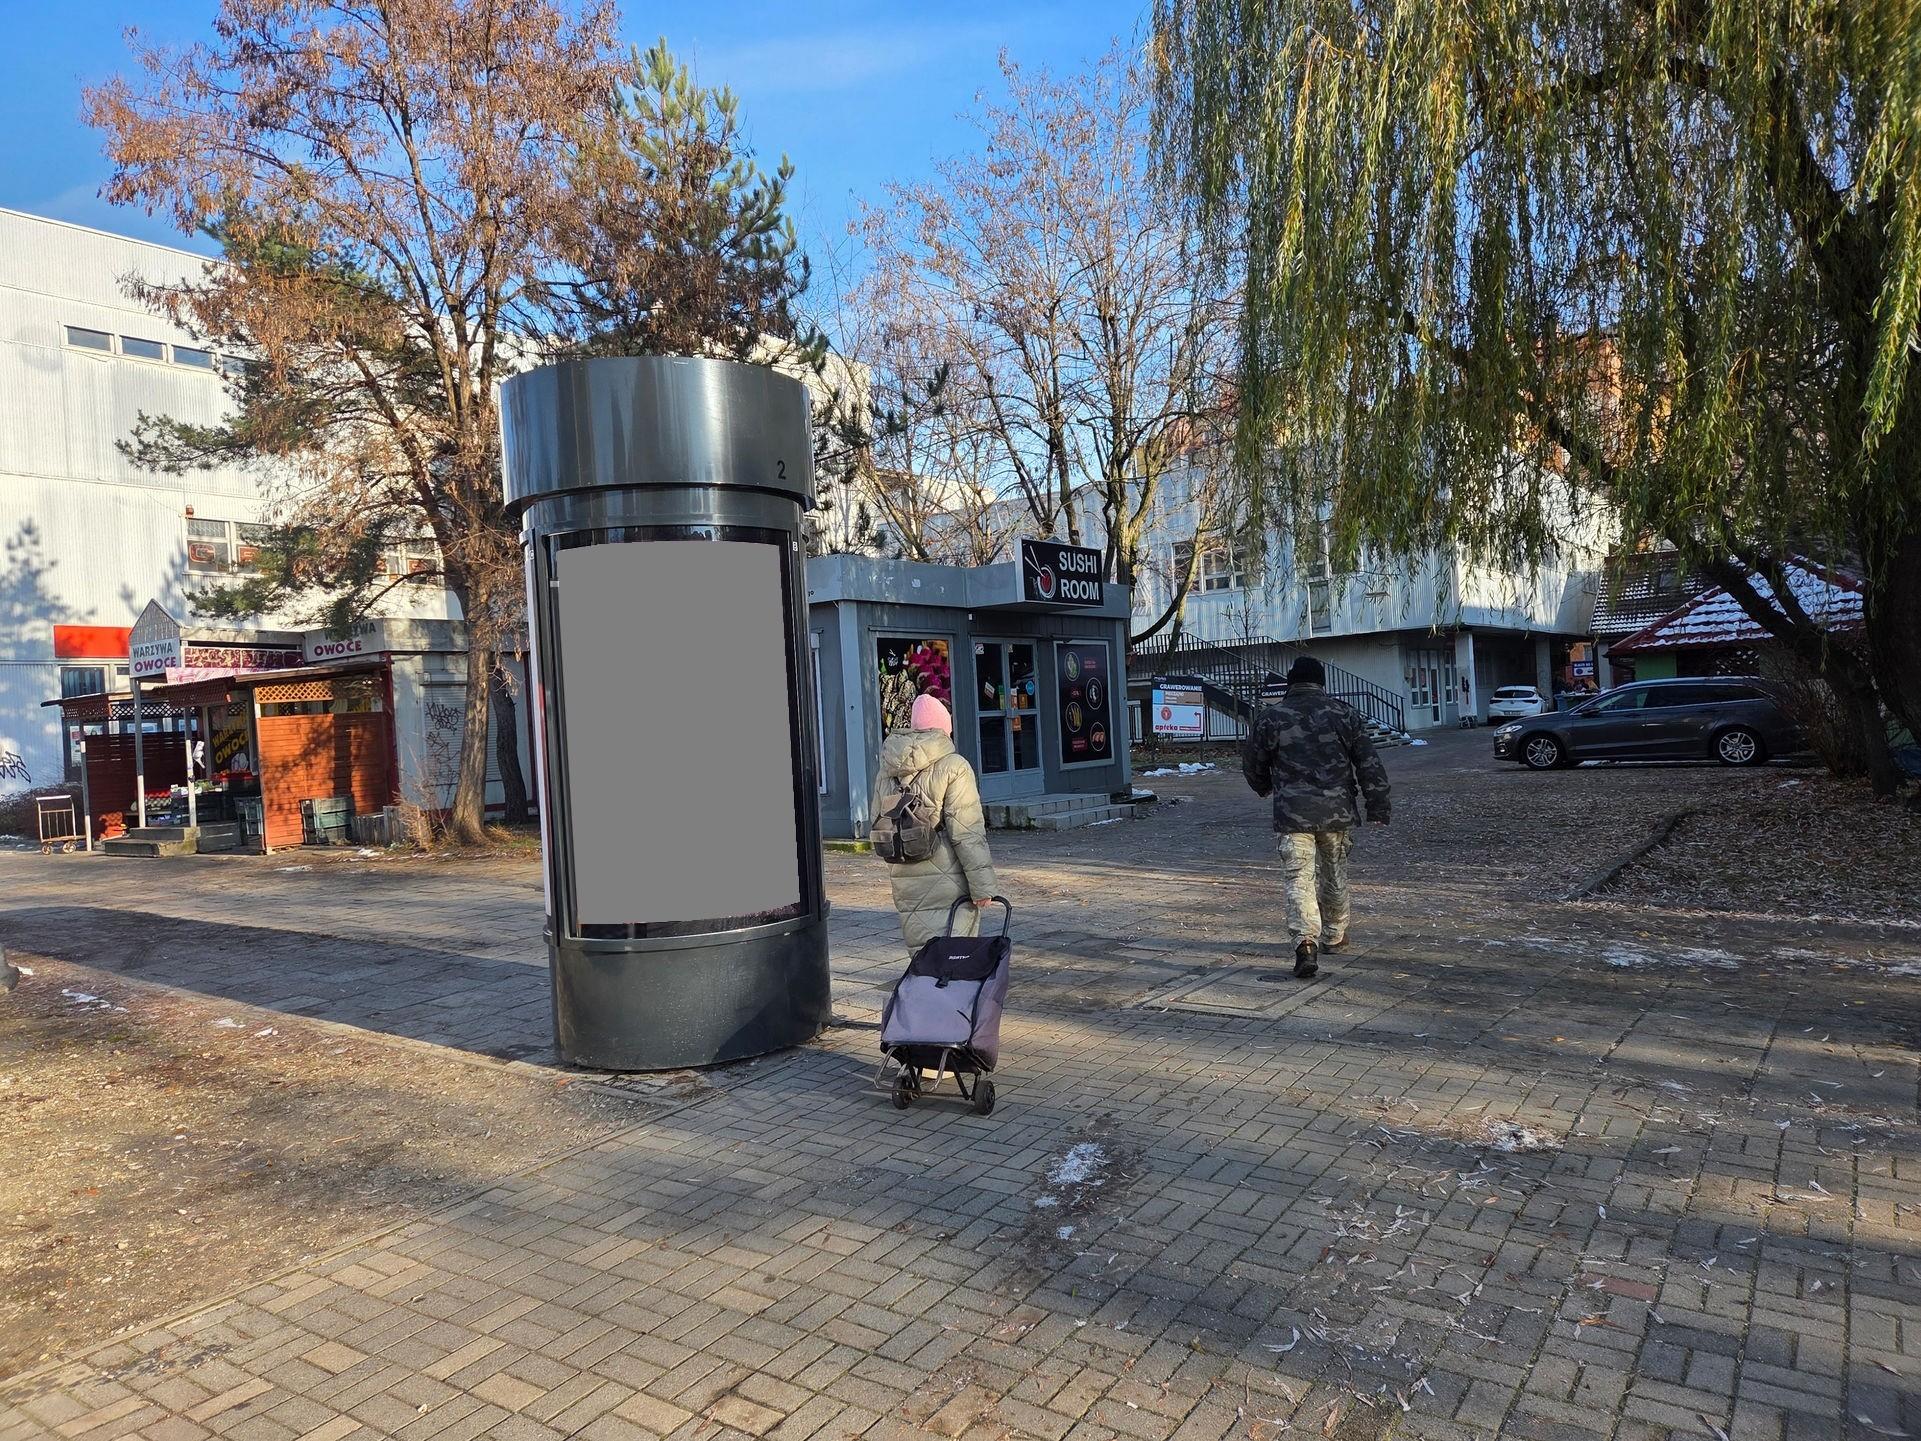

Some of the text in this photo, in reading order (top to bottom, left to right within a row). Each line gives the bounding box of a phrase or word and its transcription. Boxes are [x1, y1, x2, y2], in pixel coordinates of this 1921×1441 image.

[777, 460, 786, 480] 2
[1059, 551, 1097, 574] SUSHI
[1060, 579, 1099, 600] ROOM
[133, 642, 173, 658] WARZYWA
[314, 640, 362, 656] OWOCE
[134, 656, 177, 672] OWOCE
